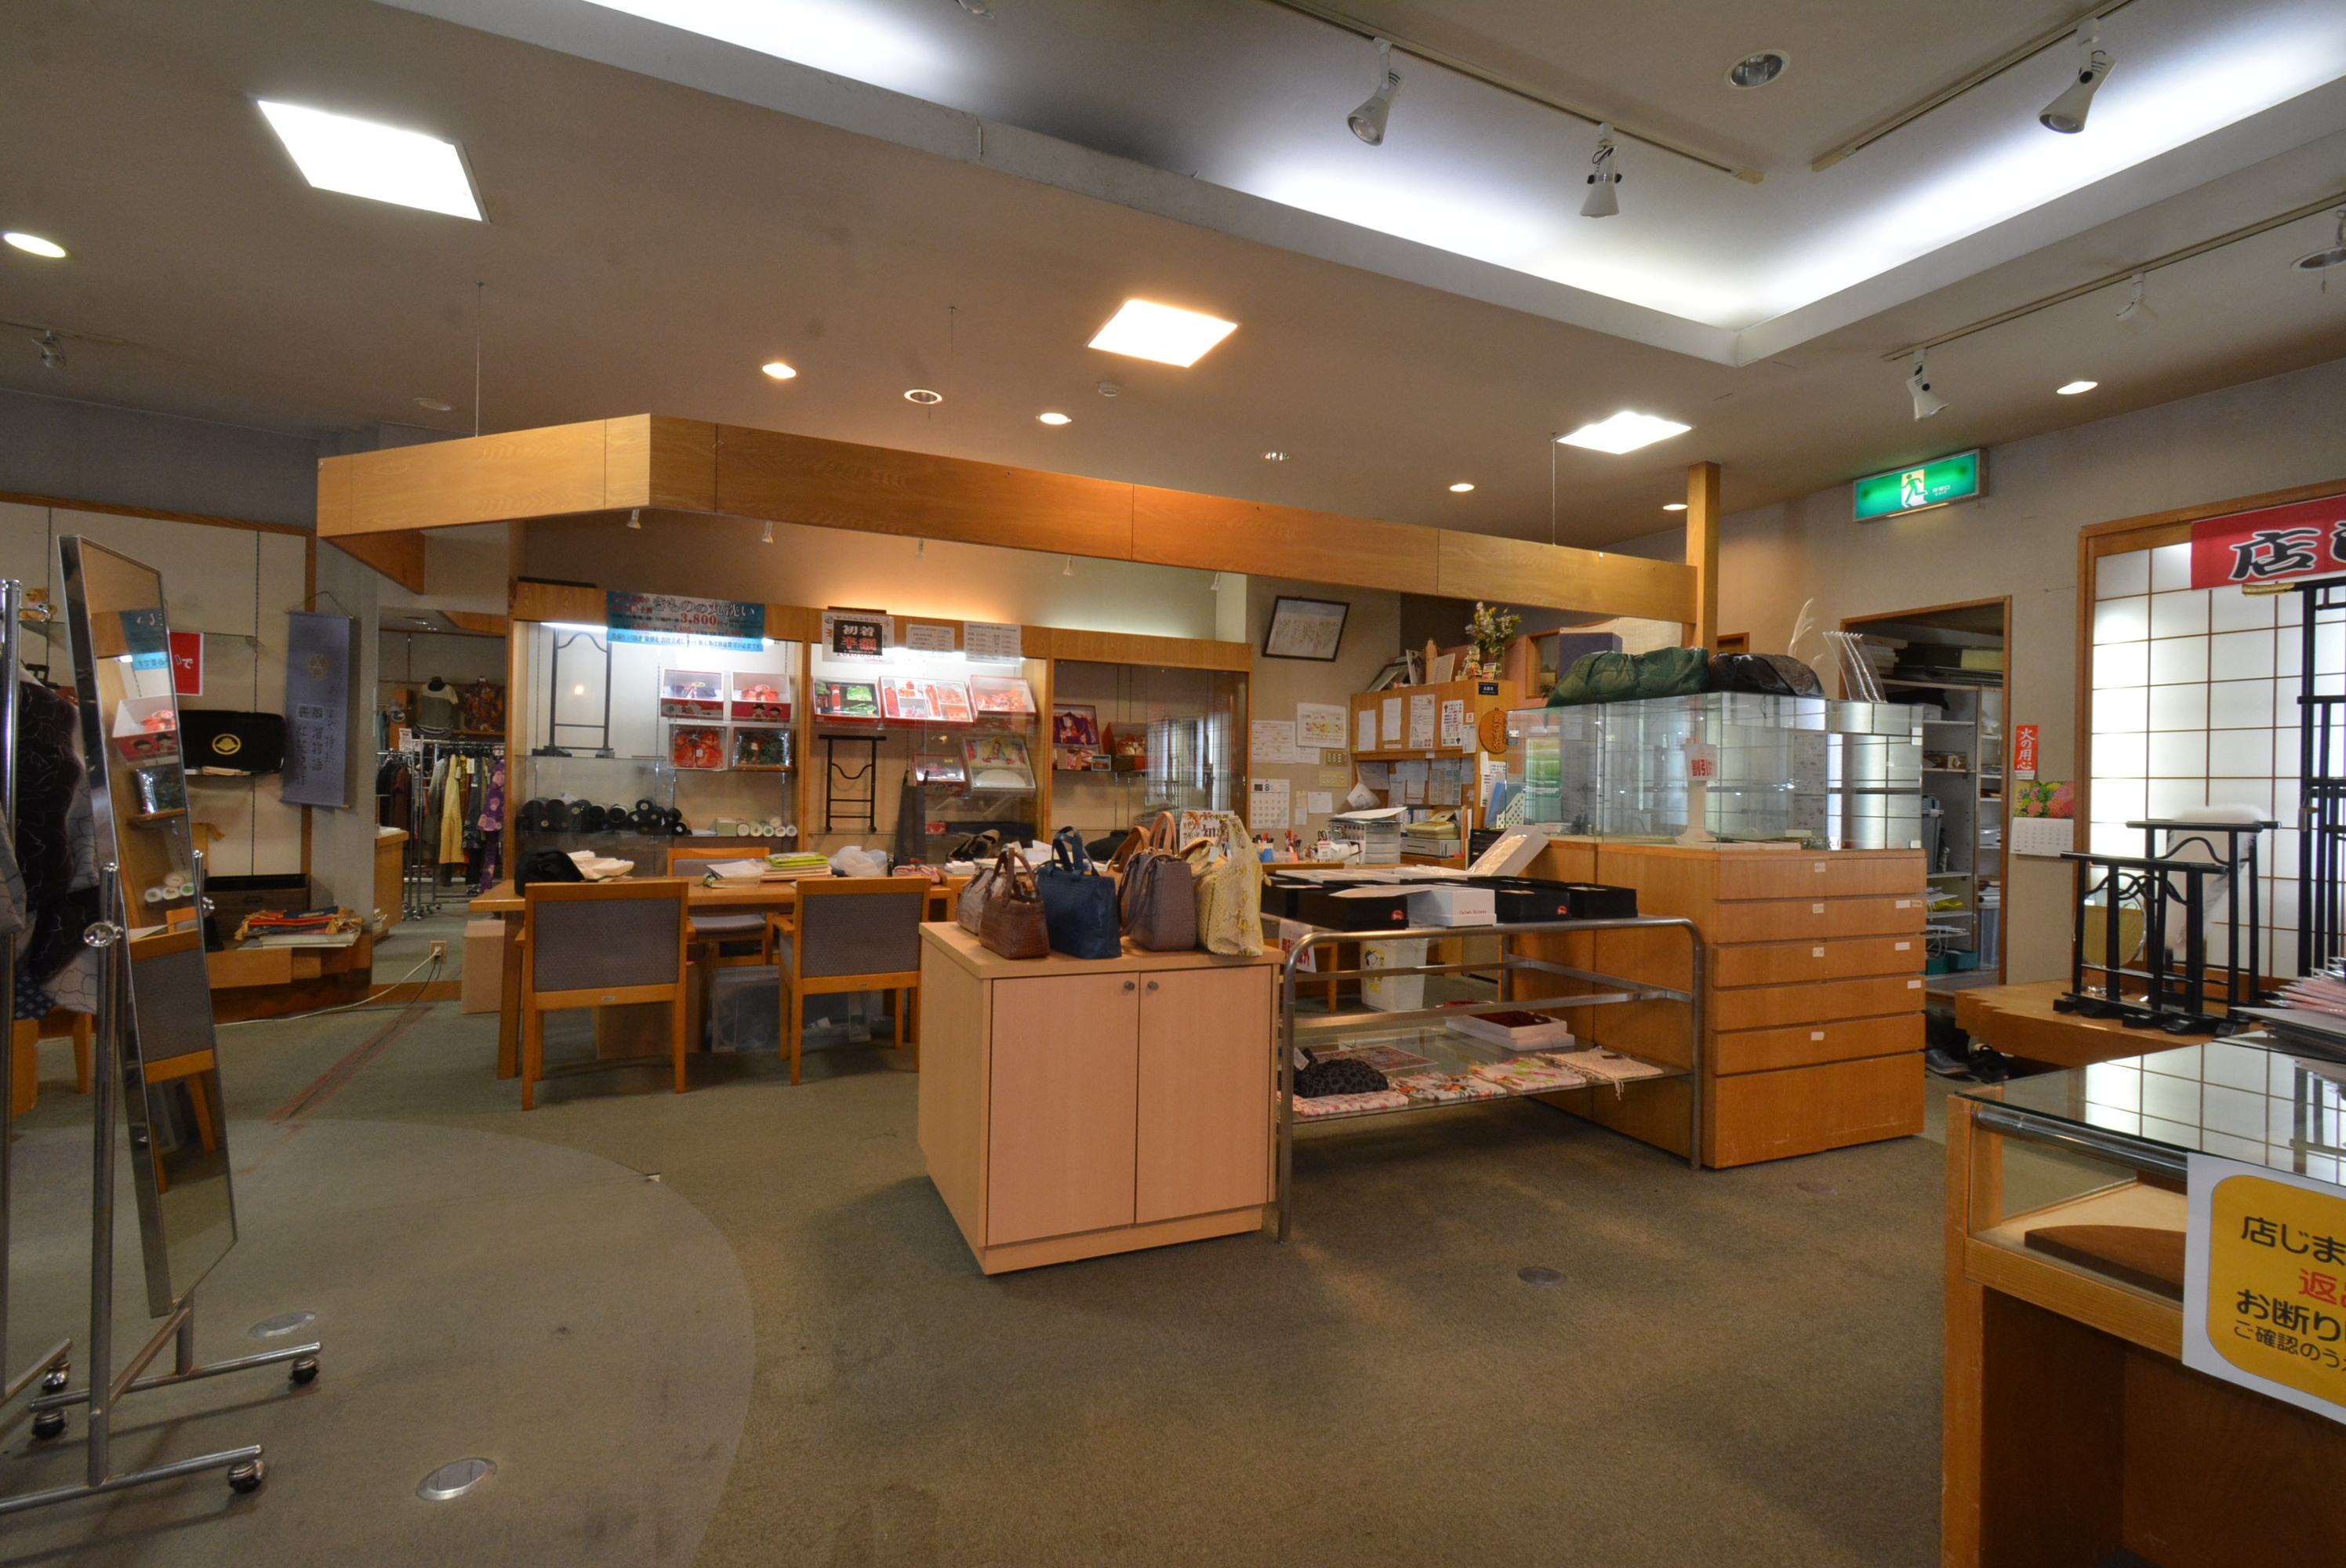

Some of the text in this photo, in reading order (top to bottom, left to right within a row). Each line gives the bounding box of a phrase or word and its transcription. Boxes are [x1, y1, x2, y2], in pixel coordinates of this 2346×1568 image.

[2228, 521, 2346, 580] 店
[652, 597, 755, 617] きものの丸洗い
[841, 637, 877, 651] 半額
[843, 625, 875, 637] 初着
[2017, 728, 2036, 770] 火の用心
[2236, 1288, 2346, 1342] お断り
[2234, 1319, 2346, 1372] ご確認のう
